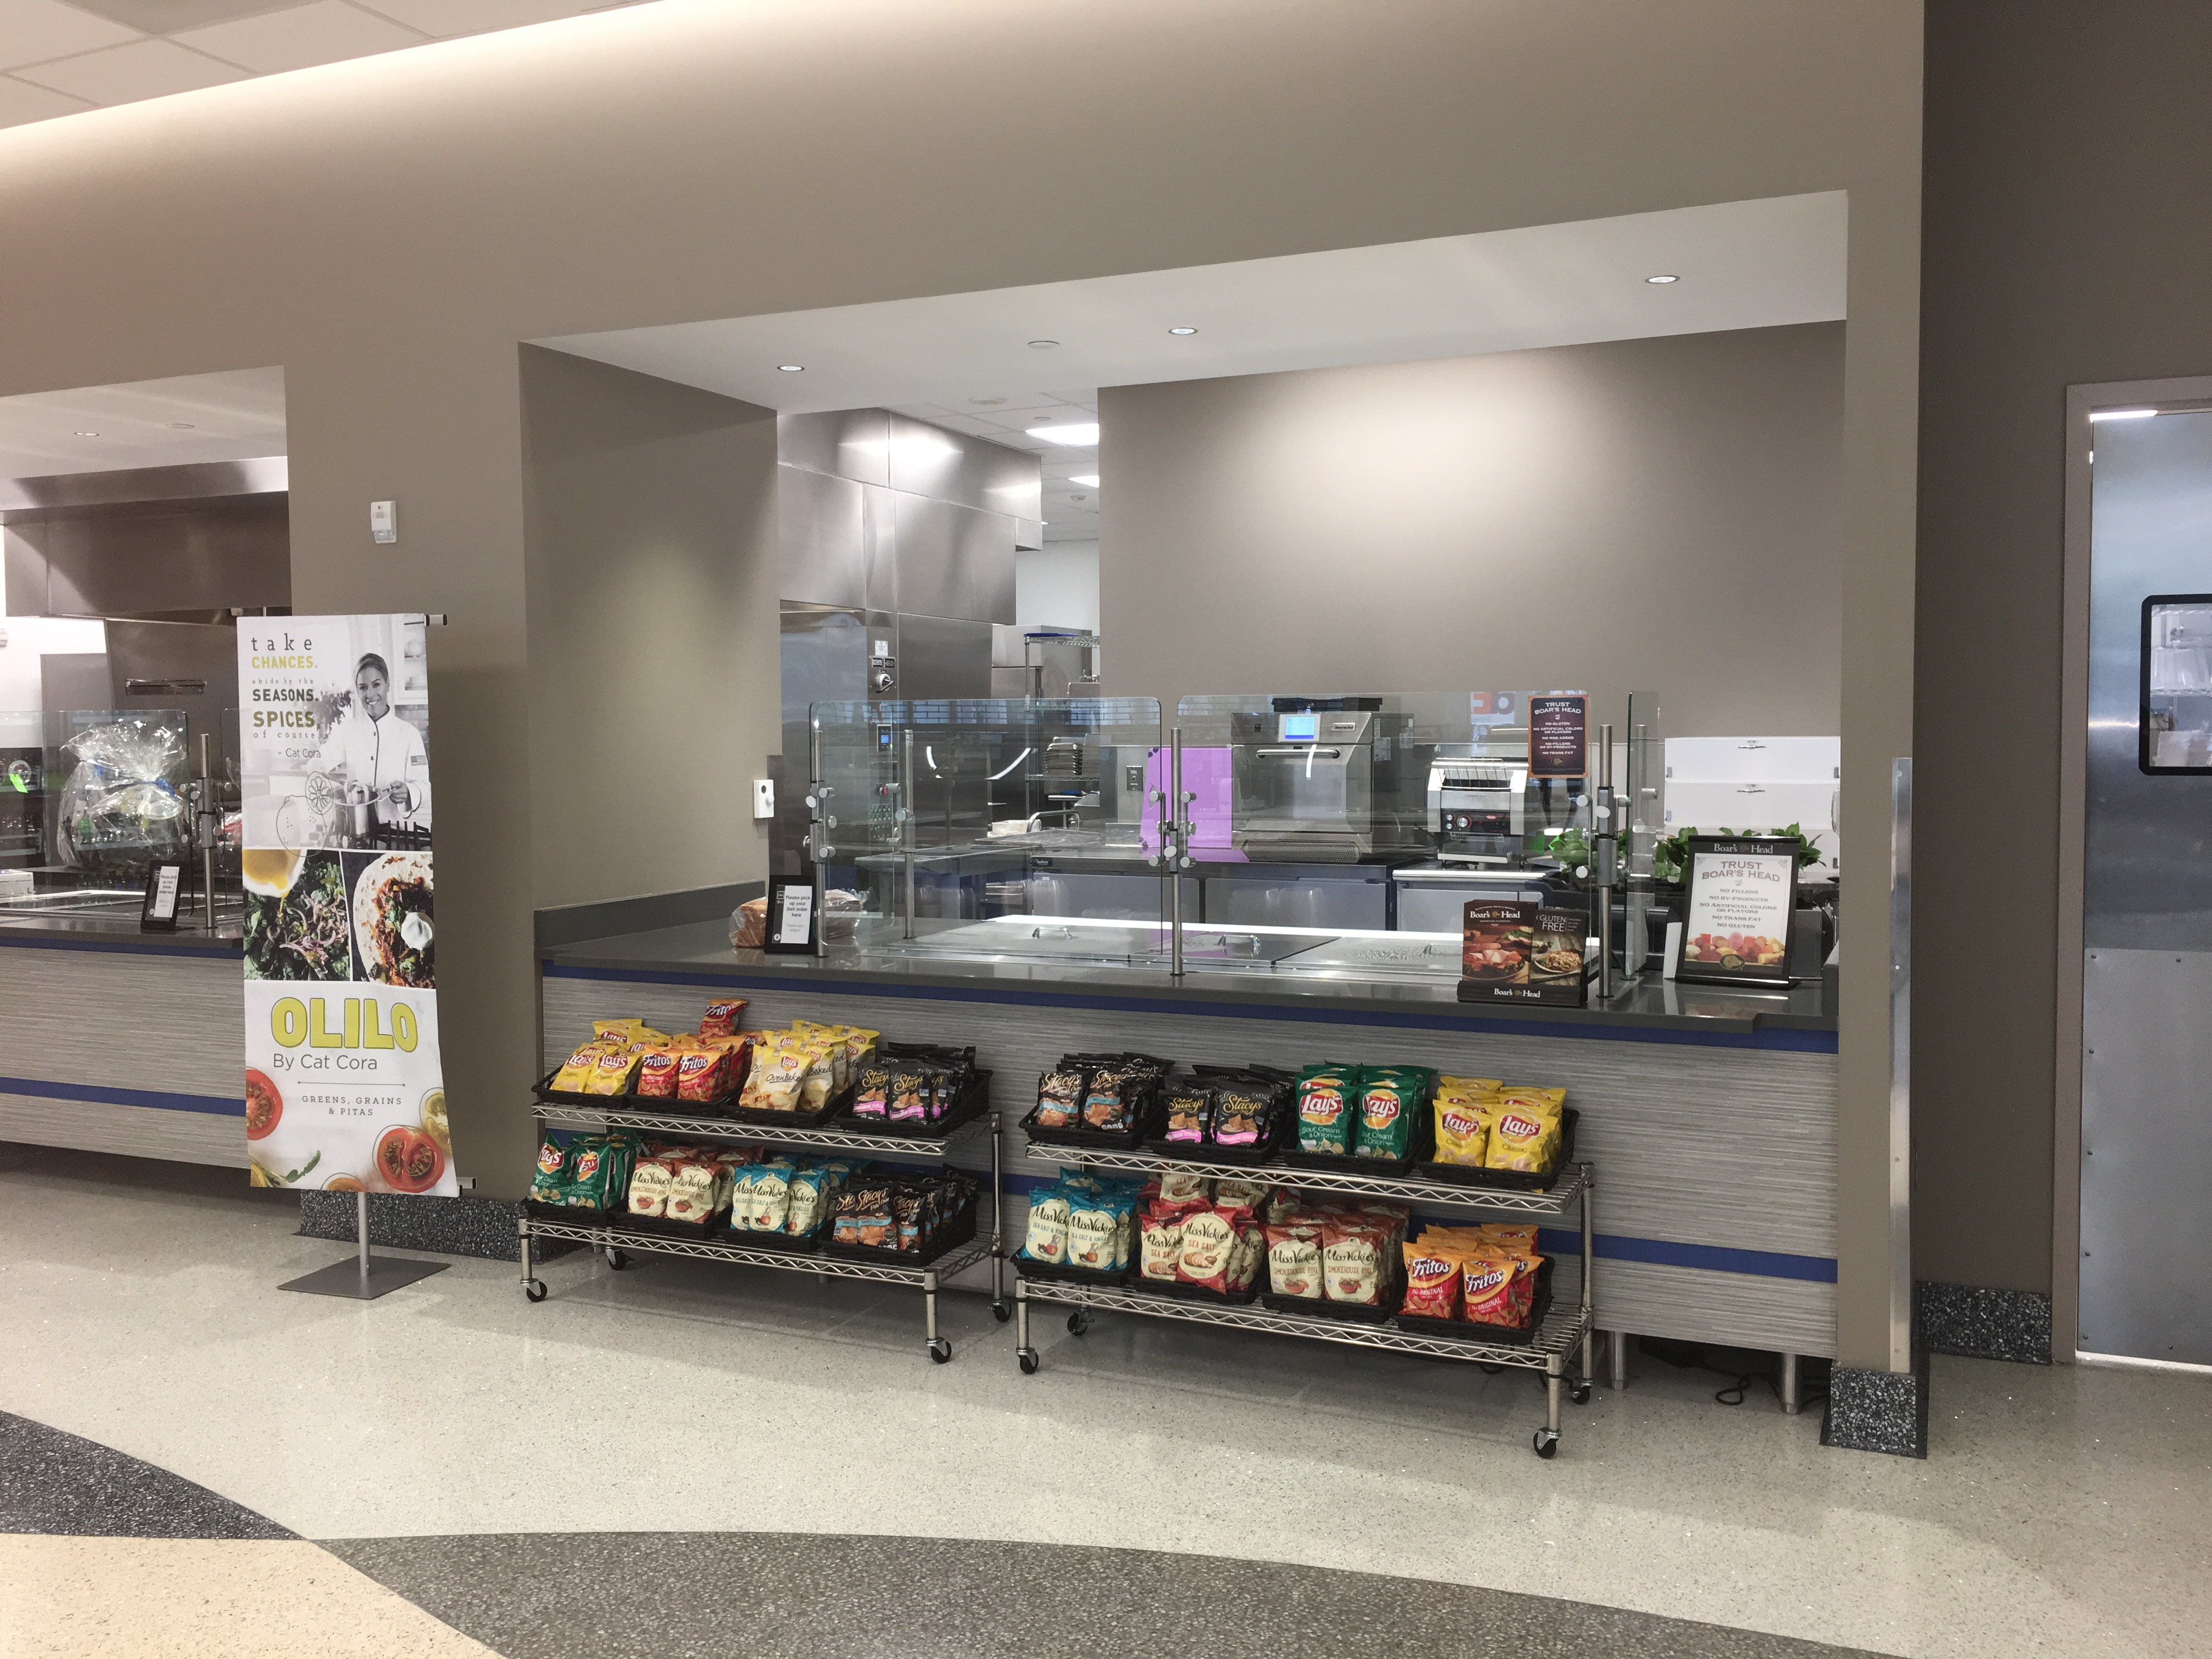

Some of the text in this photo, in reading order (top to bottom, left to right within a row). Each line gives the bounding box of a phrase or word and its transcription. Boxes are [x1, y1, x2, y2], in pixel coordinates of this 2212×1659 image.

[251, 633, 312, 651] take
[251, 656, 318, 669] CHANCES.
[252, 689, 318, 701] SEASONS.
[285, 748, 300, 757] Cat
[302, 748, 321, 758] Cora
[1714, 843, 1773, 854] Boar's Head
[1721, 861, 1762, 870] TRUST
[1702, 870, 1780, 882] BOAR'S HEAD
[1539, 915, 1566, 923] GLUTEN
[1542, 922, 1565, 932] FREE
[1523, 990, 1541, 998] Head
[705, 1003, 734, 1015] Frito
[271, 997, 418, 1053] OLILO
[274, 1054, 377, 1071] By Cat Cora
[600, 1054, 627, 1068] Lay's
[643, 1054, 670, 1066] Fritos
[680, 1055, 708, 1073] Fritos
[782, 1056, 798, 1067] Lay's
[862, 1069, 889, 1087] Stacy
[1040, 1072, 1082, 1093] Stacy's
[302, 1096, 351, 1105] GREENS,
[1168, 1097, 1204, 1113] Stacy's
[1223, 1094, 1262, 1114] Stacy's
[1302, 1095, 1341, 1115] Lay's
[1444, 1114, 1477, 1133] Lay's
[1502, 1116, 1538, 1136] Lay's
[1446, 1138, 1471, 1149] Classic
[1502, 1143, 1527, 1152] Classic
[1188, 1240, 1199, 1248] SEA
[1412, 1257, 1451, 1278] Fritos
[1465, 1271, 1503, 1293] Fritos
[1419, 1286, 1444, 1295] ORIGINAL
[1477, 1297, 1502, 1310] ORIGINAL
